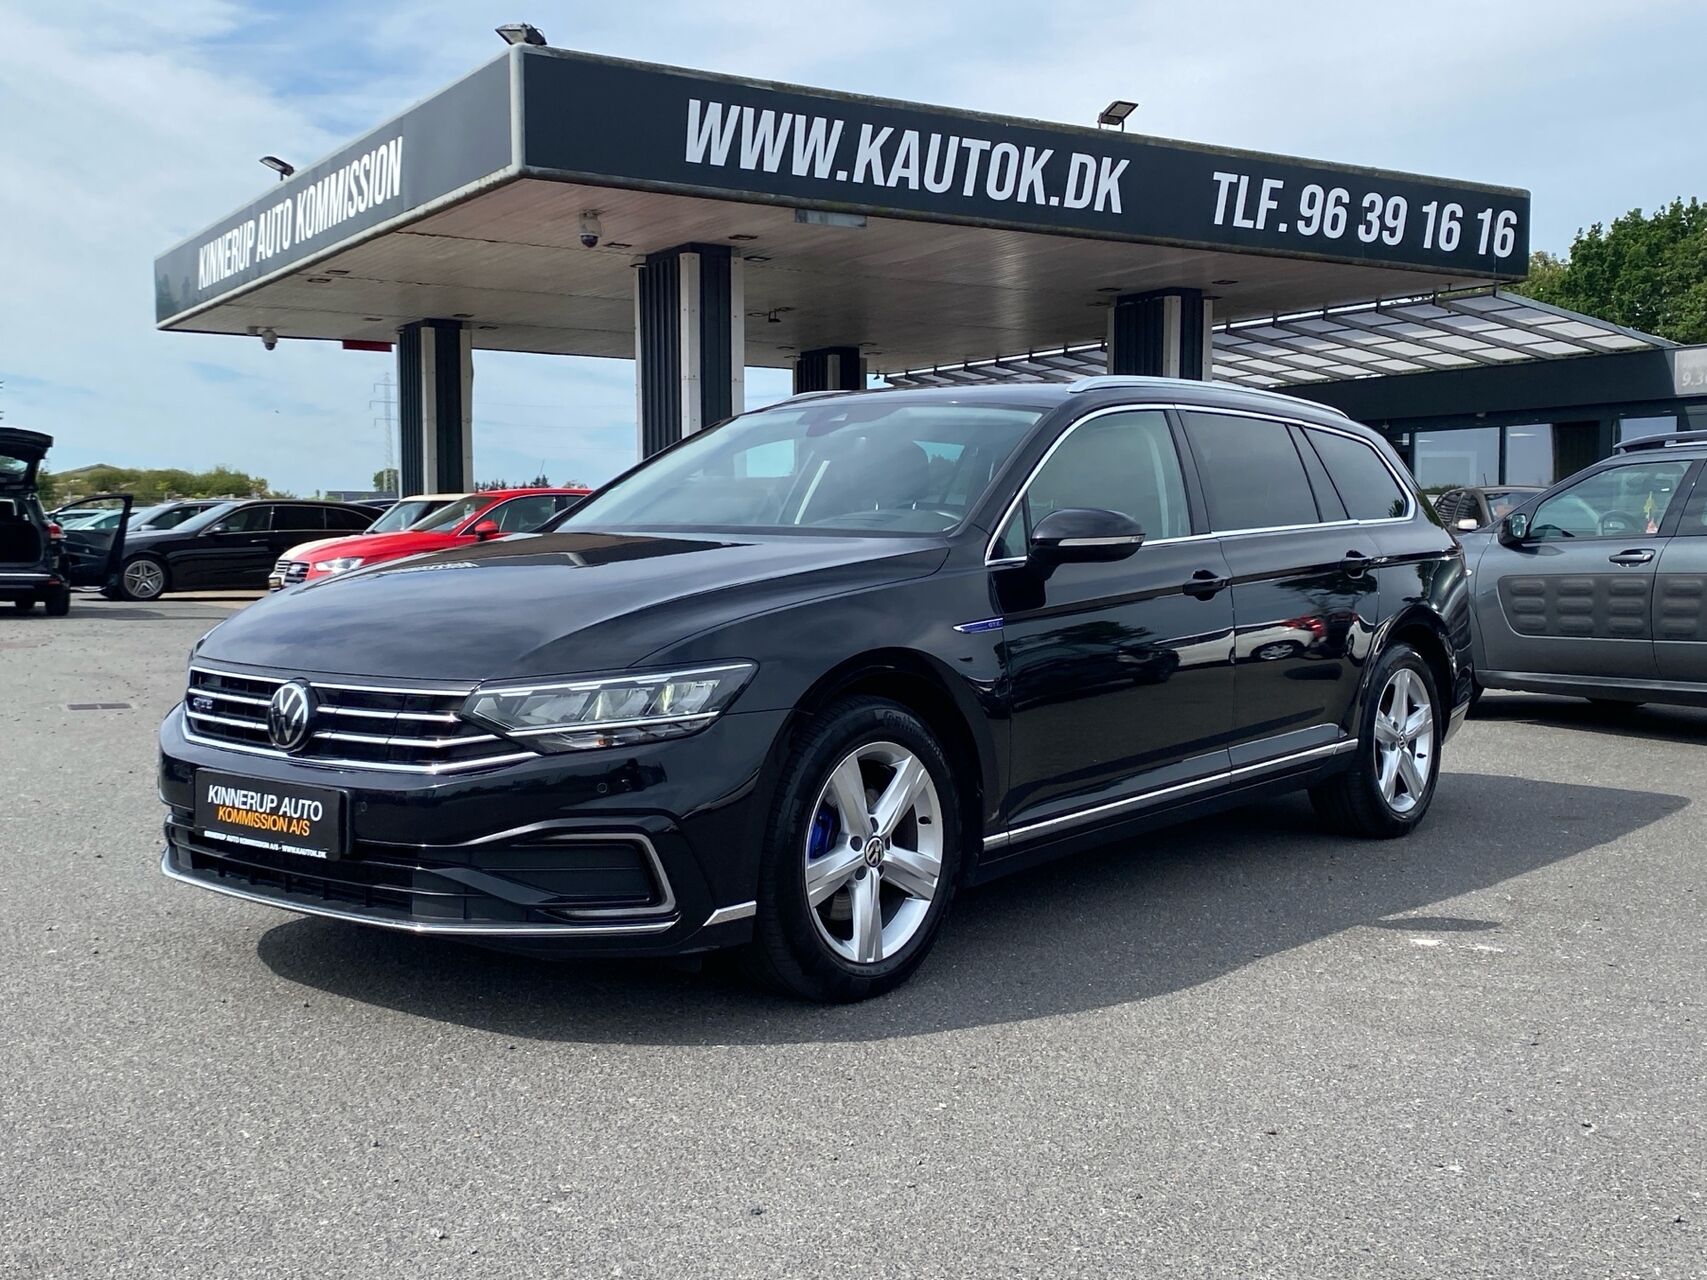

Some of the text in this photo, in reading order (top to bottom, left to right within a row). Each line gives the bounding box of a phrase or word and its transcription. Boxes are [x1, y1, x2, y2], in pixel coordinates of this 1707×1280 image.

[684, 98, 1131, 214] WWW.KAUTOK.DK
[198, 136, 403, 290] KINNERUP AUTO KOMMISSION
[1212, 171, 1518, 258] TLF. 96 39 16 16
[208, 784, 322, 821] KINNERUP AUTO
[218, 806, 310, 836] KOMMISSION A/S
